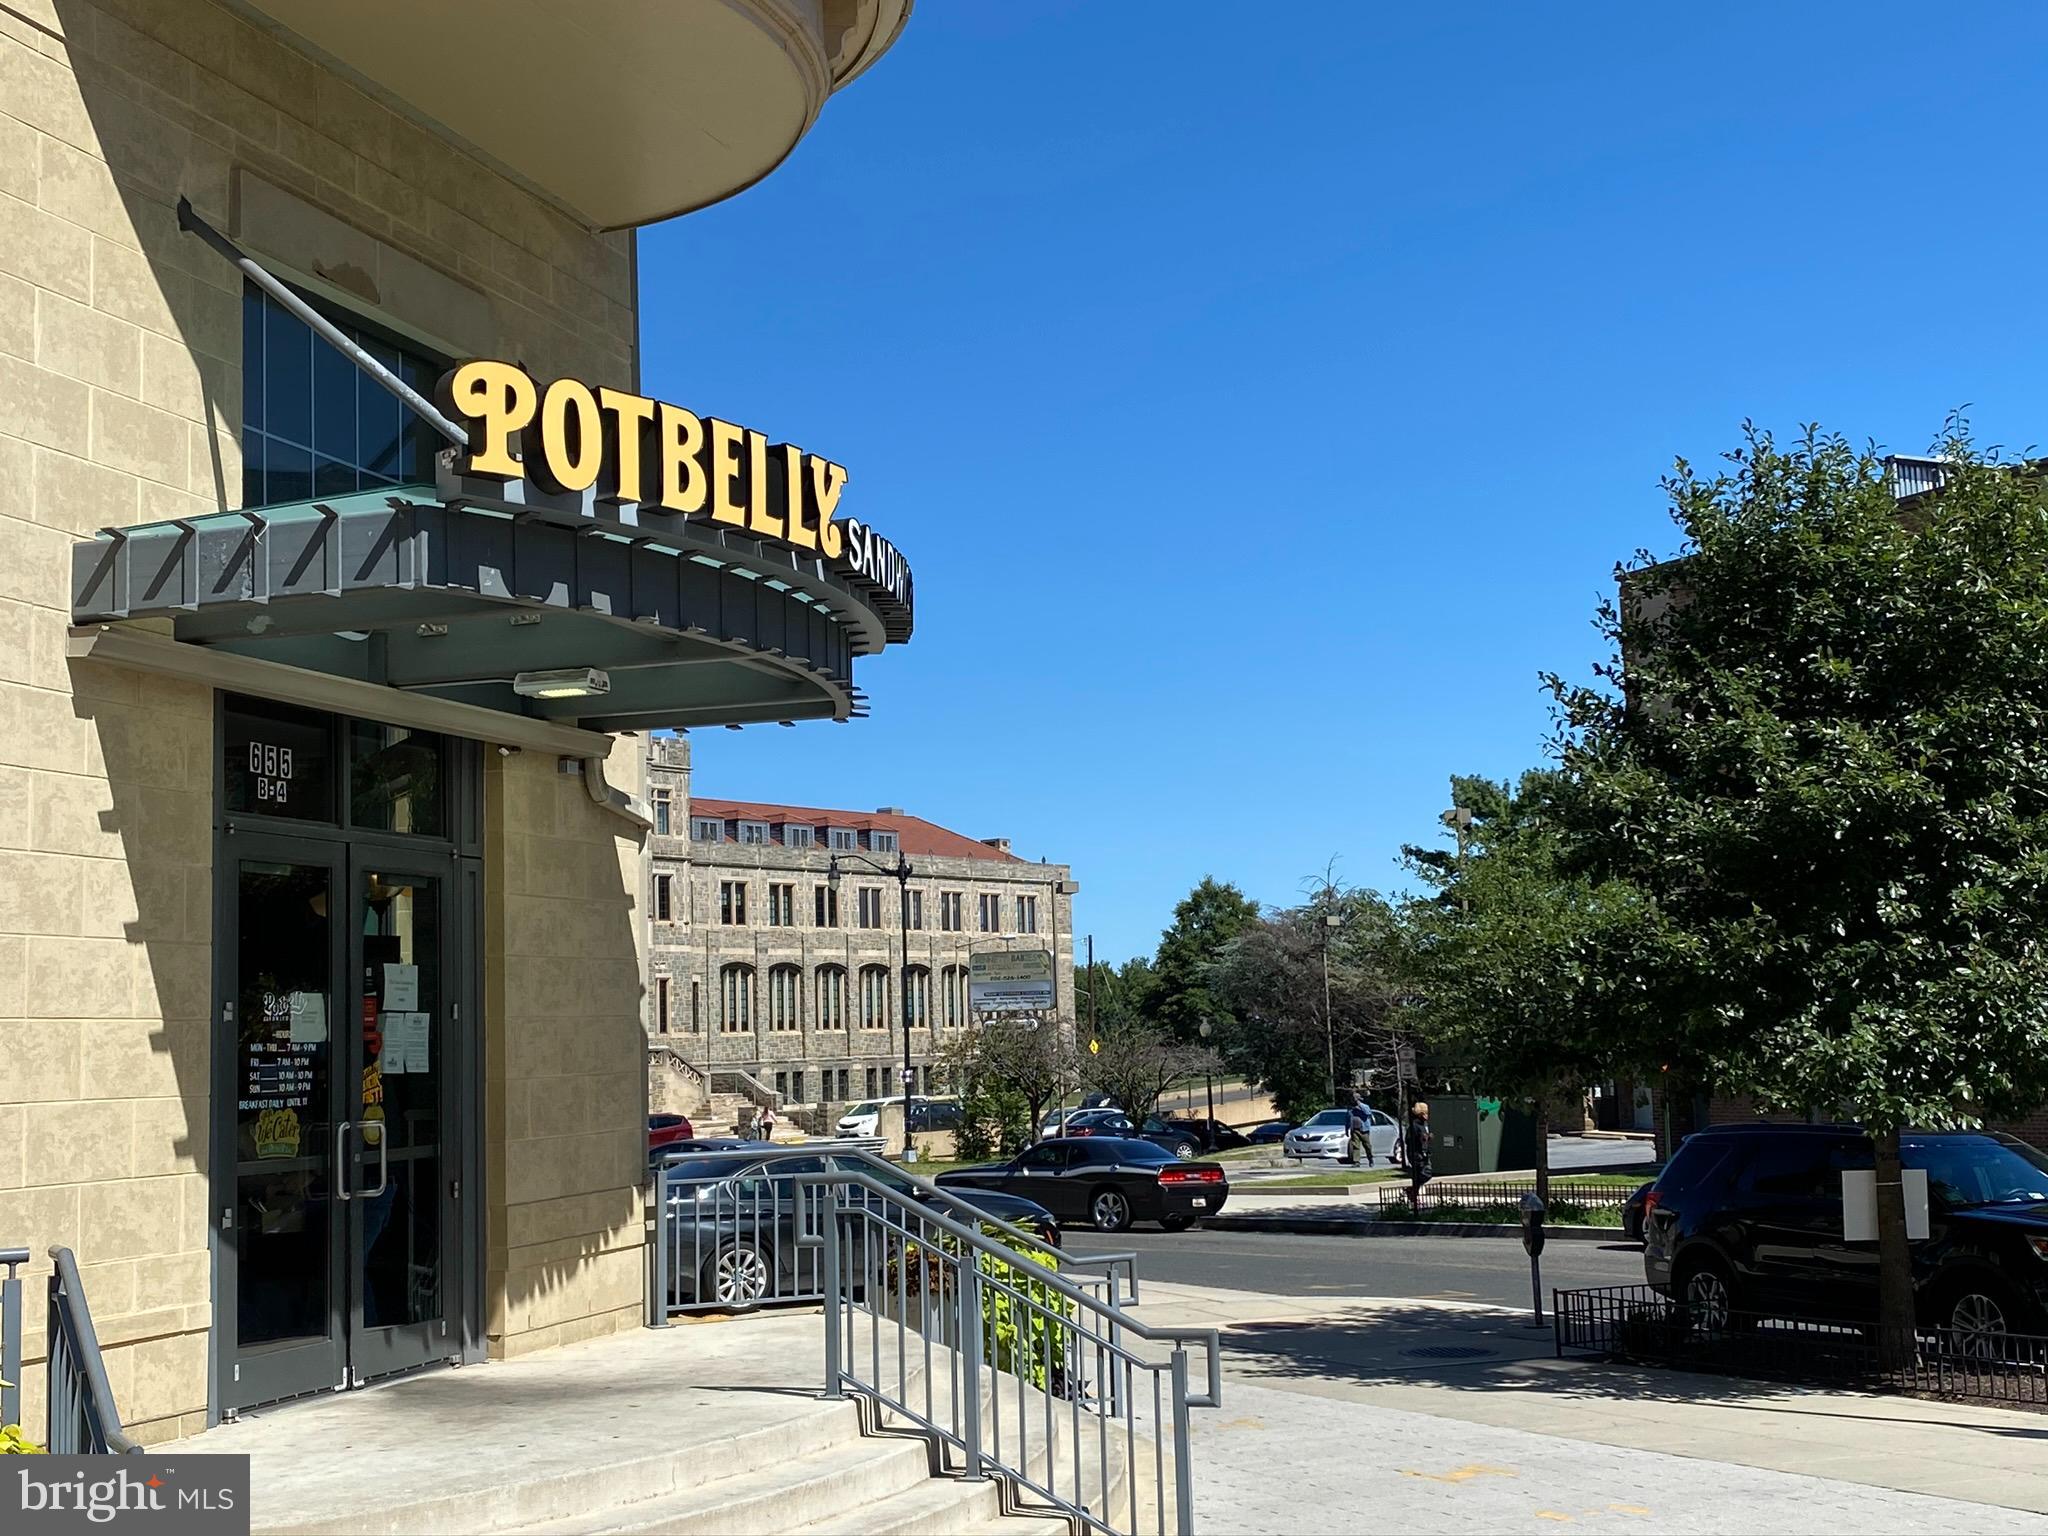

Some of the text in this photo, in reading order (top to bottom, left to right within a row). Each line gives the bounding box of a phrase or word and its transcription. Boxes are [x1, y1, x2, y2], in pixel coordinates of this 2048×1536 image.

[451, 360, 909, 609] POTBELLY SANDW
[251, 743, 291, 778] 655
